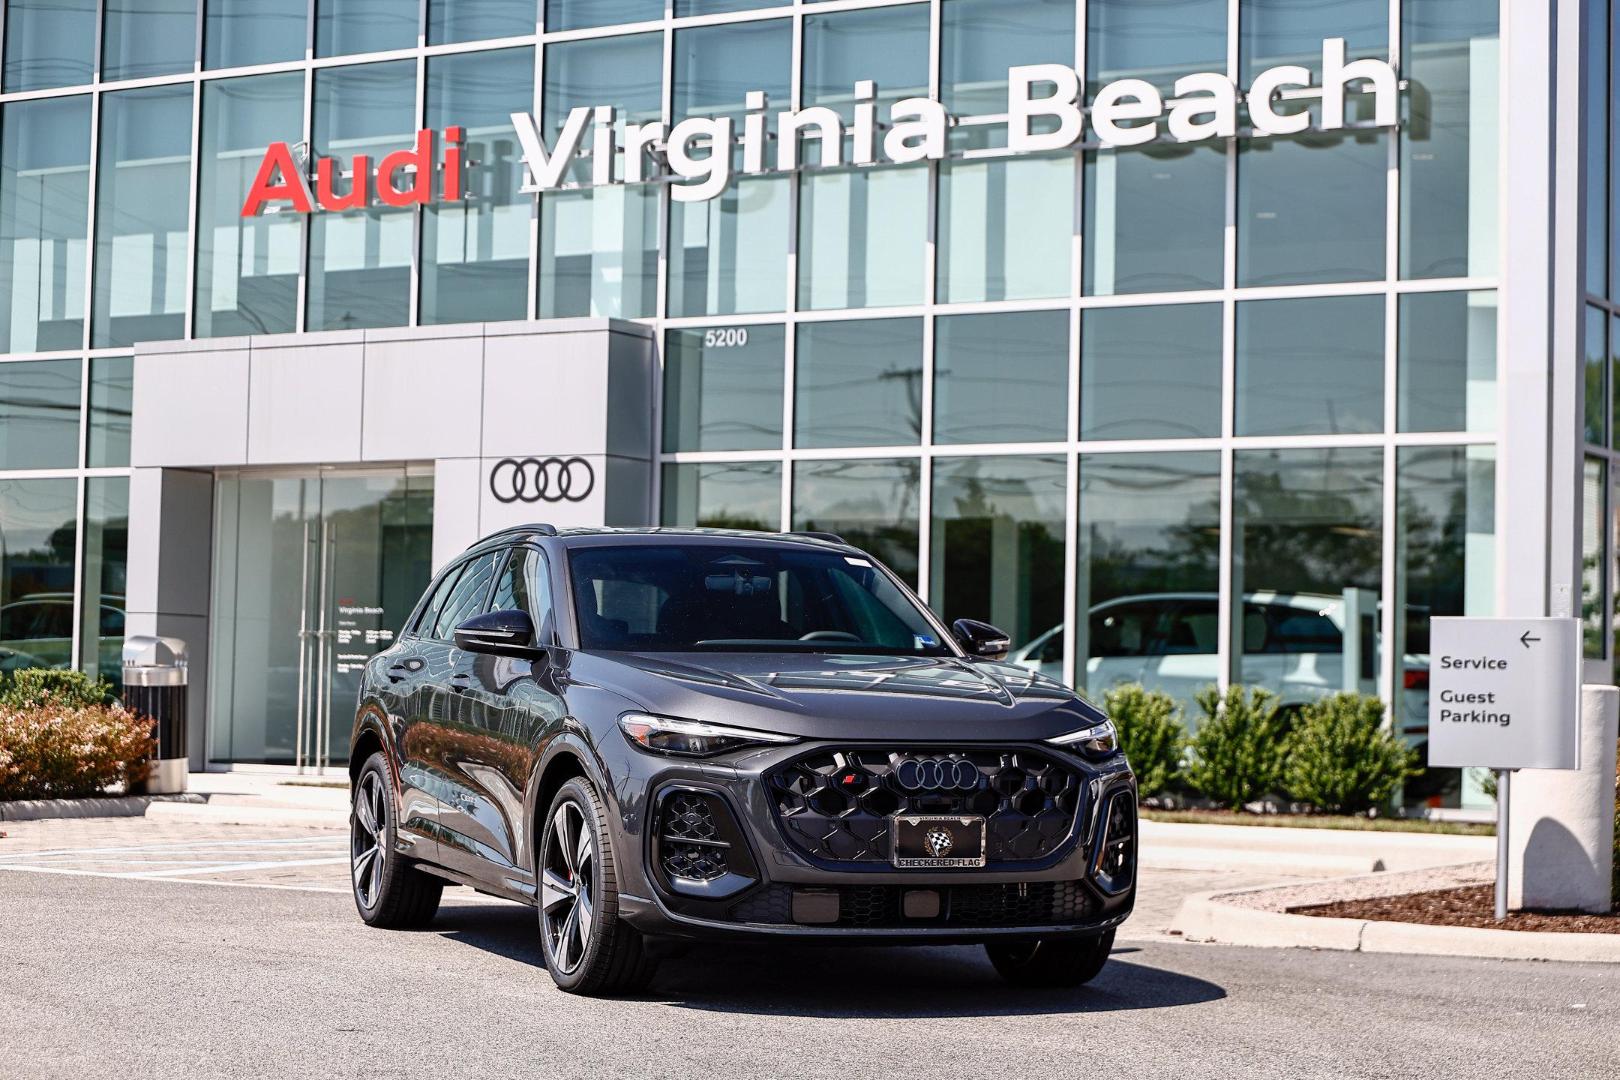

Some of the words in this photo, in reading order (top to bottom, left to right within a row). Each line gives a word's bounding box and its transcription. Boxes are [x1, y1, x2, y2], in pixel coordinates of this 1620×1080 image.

[240, 126, 464, 218] Audi
[511, 79, 949, 203] Virginia
[1008, 37, 1401, 153] Beach
[705, 328, 747, 347] 5200
[1441, 655, 1508, 670] Service
[1440, 690, 1496, 704] Guest
[1440, 709, 1511, 727] Parking
[899, 859, 955, 867] CHECKERED
[957, 859, 980, 867] FLAG
